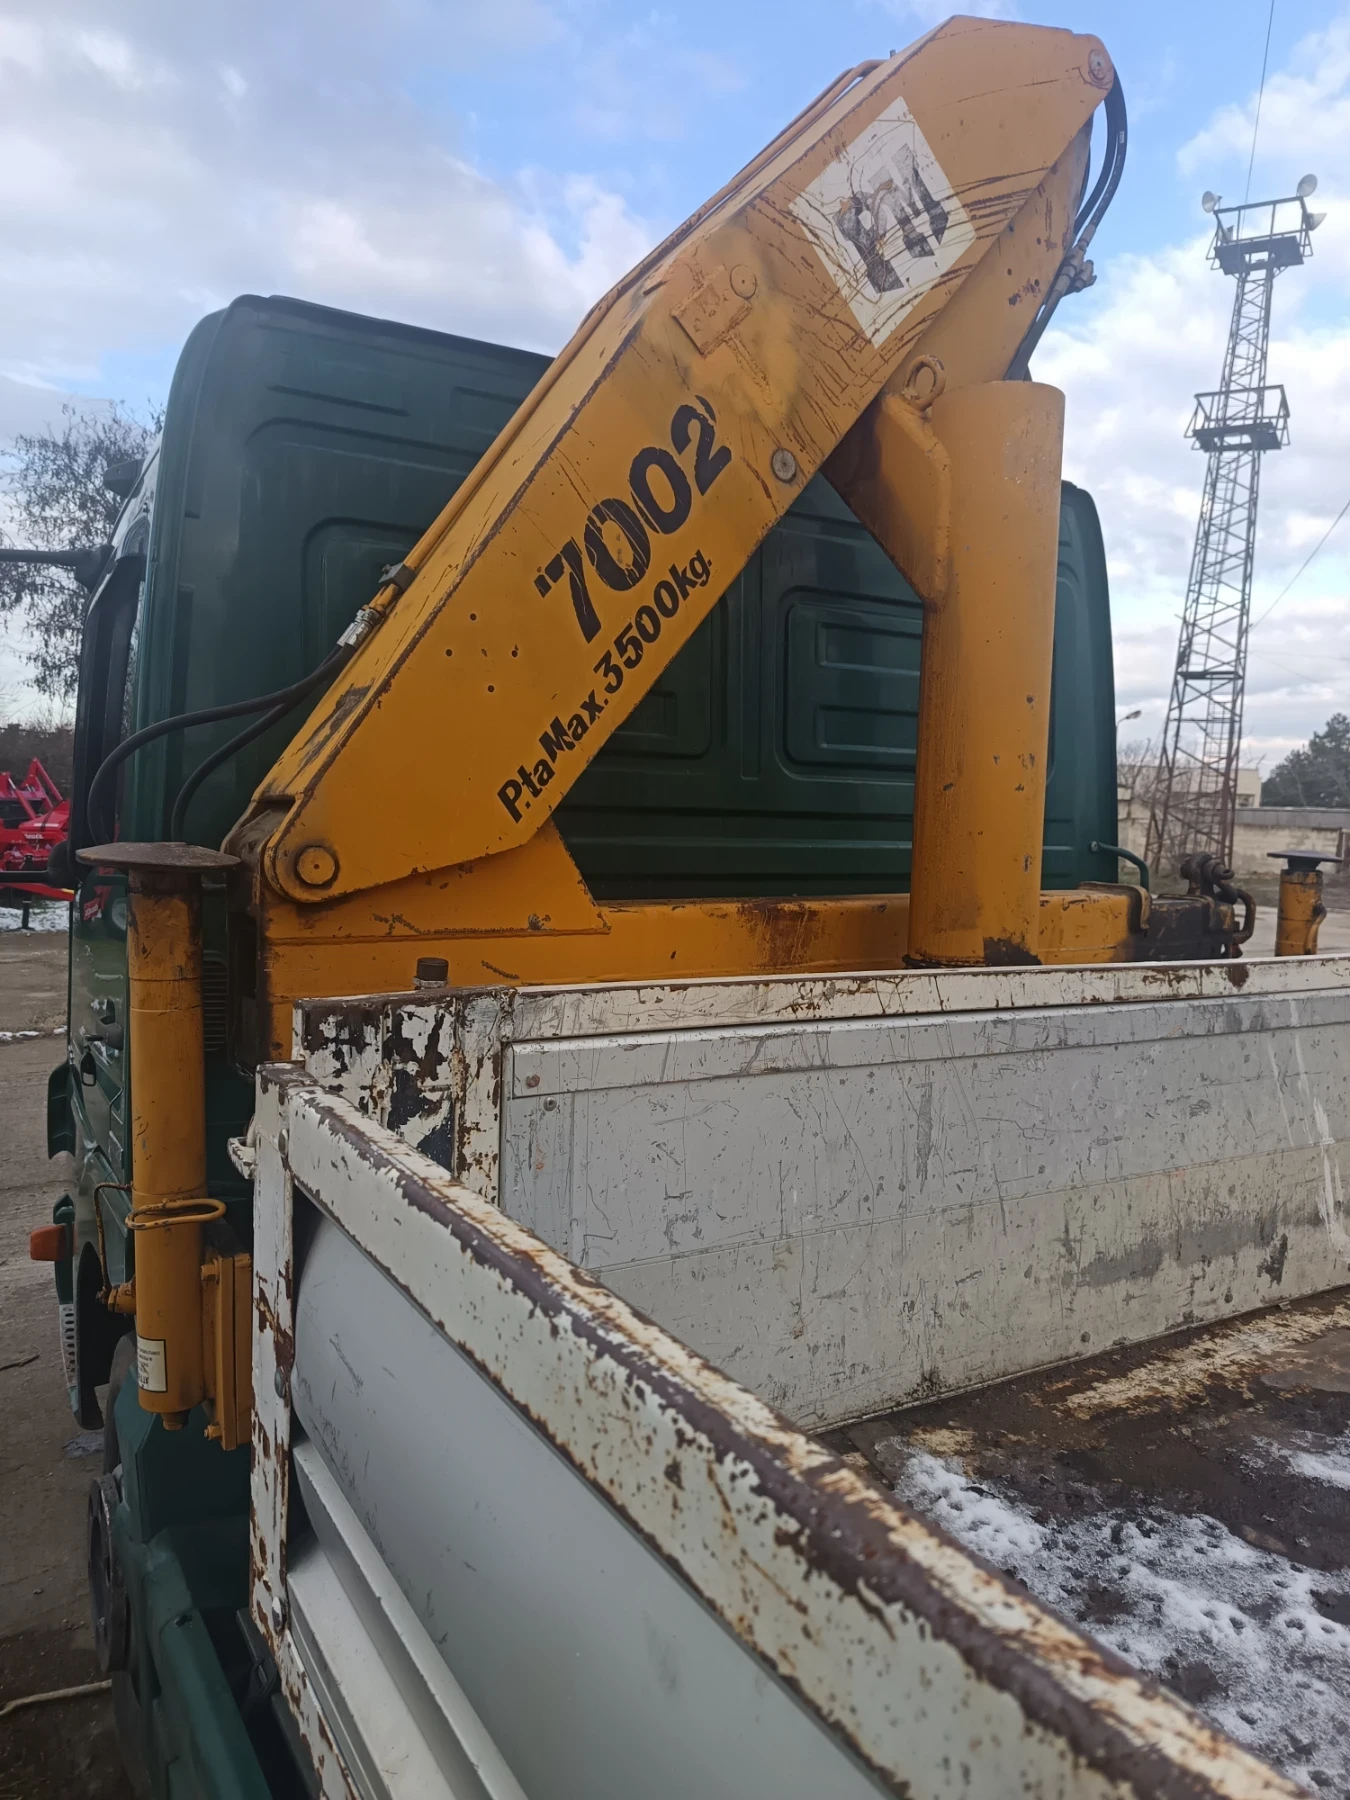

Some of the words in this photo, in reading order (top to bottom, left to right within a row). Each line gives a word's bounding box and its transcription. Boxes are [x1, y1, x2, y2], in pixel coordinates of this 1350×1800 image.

[534, 394, 732, 644] 7002
[538, 688, 609, 764] Max.
[592, 549, 713, 694] 3500kg.
